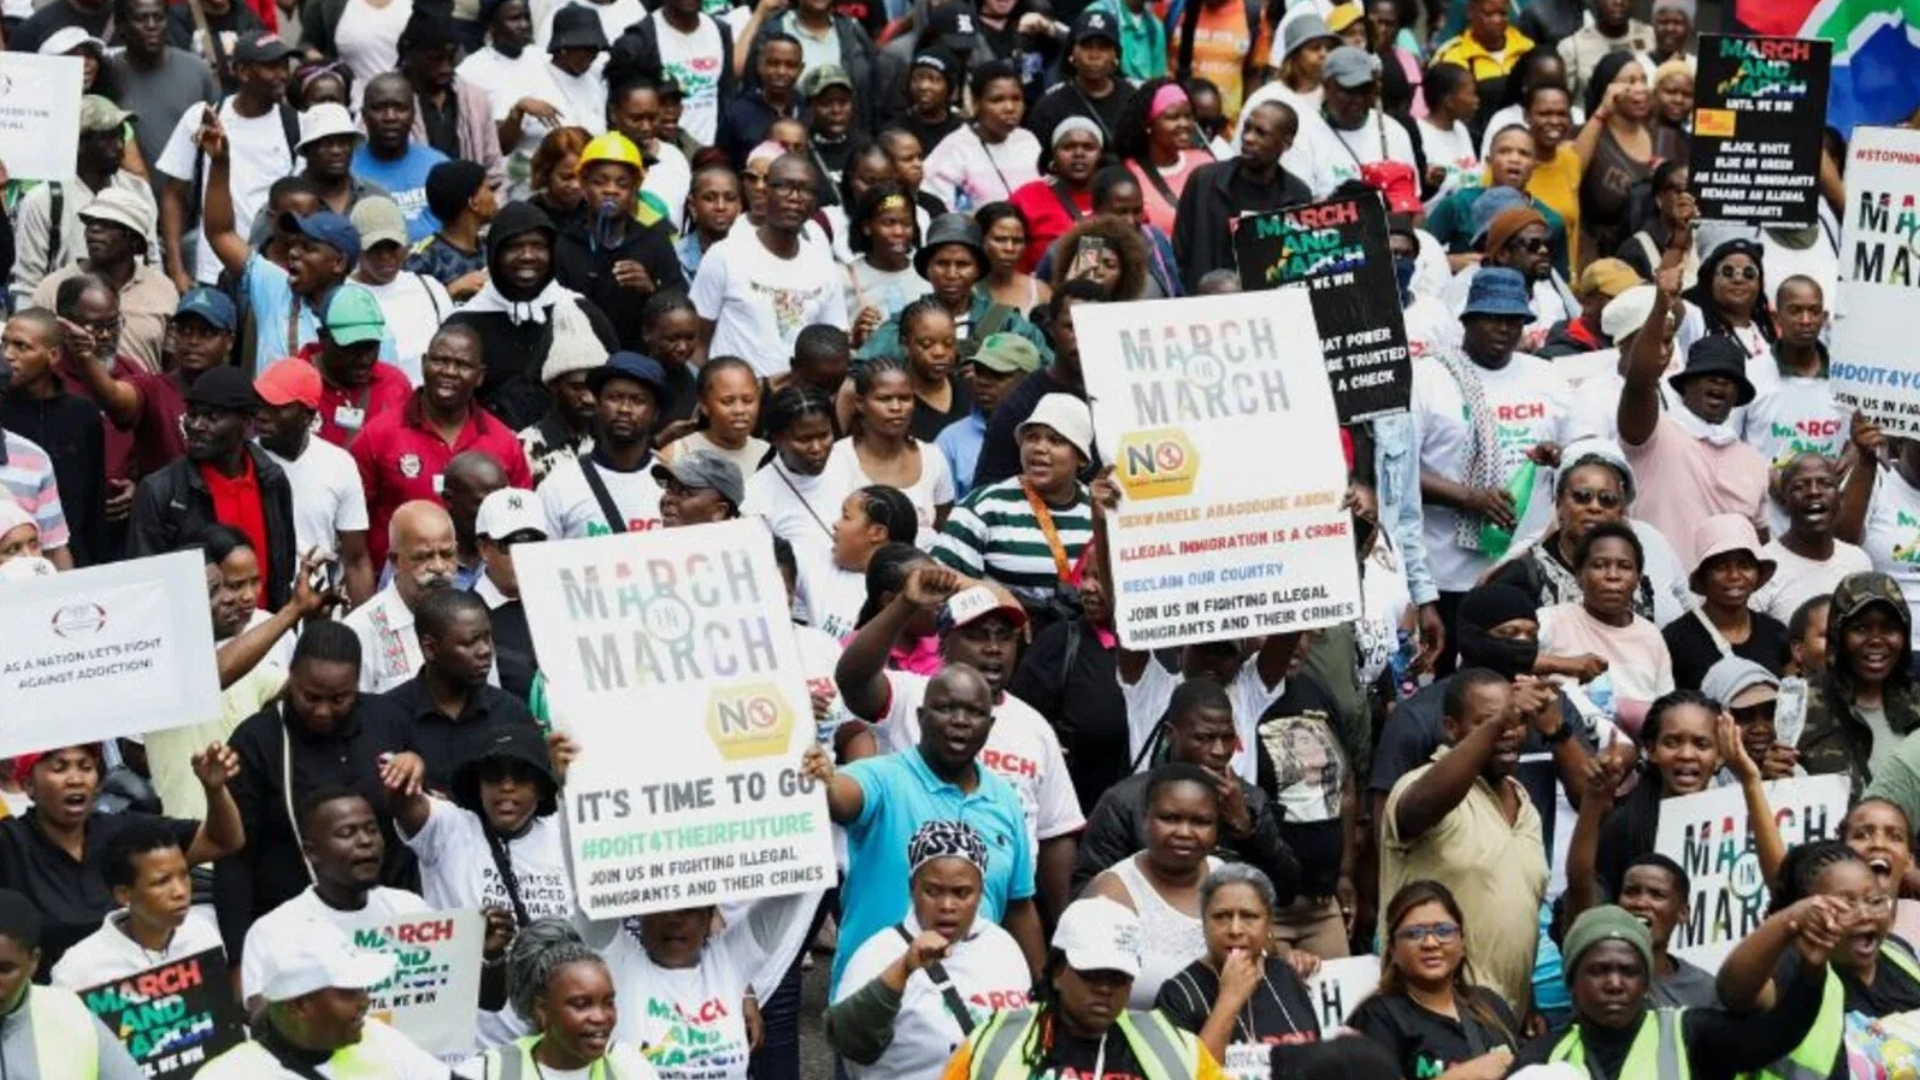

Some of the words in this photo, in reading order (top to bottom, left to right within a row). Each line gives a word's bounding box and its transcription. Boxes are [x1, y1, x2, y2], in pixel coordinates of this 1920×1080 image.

[1719, 37, 1811, 61] MARCH
[1738, 59, 1791, 78] AND
[1254, 201, 1360, 239] MARCH
[1281, 228, 1341, 257] AND
[1312, 276, 1331, 290] WE
[1118, 316, 1280, 372] MARCH
[1346, 327, 1392, 349] POWER
[1346, 347, 1406, 370] TRUSTED
[1130, 368, 1291, 427] MARCH
[1337, 378, 1348, 392] A
[1350, 370, 1395, 390] CHECK
[1833, 391, 1859, 407] JOIN
[1863, 396, 1879, 410] US
[1883, 399, 1896, 412] IN
[1119, 541, 1177, 562] ILLEGAL
[1179, 531, 1268, 557] IMMIGRATION
[1272, 529, 1286, 544] IS
[1290, 527, 1301, 542] A
[1304, 521, 1348, 540] CRIME
[557, 548, 761, 621] MARCH
[1122, 575, 1184, 594] RECLAIM
[1187, 569, 1216, 586] OUR
[1220, 562, 1285, 582] COUNTRY
[1127, 605, 1159, 623] JOIN
[1162, 601, 1182, 619] US
[1186, 600, 1200, 616] IN
[1203, 592, 1268, 613] FIGHTING
[1272, 585, 1329, 604] ILLEGAL
[1128, 619, 1216, 643] IMMIGRANTS
[1220, 615, 1250, 632] AND
[1254, 609, 1297, 627] THEIR
[1301, 601, 1355, 621] CRIMES
[3, 662, 21, 675] AS
[23, 660, 34, 671] A
[36, 651, 85, 669] NATION
[124, 636, 162, 653] FIGHT
[576, 614, 778, 692] MARCH
[18, 671, 74, 690] AGAINST
[982, 748, 1037, 780] RCH
[577, 788, 632, 825] IT'S
[641, 777, 716, 816] TIME
[726, 771, 767, 805] TO
[778, 767, 816, 798] GO
[581, 811, 816, 862] #DOIT4THEIRFUTURE
[589, 868, 621, 886] JOIN
[625, 865, 646, 882] US
[650, 863, 664, 879] IN
[669, 854, 735, 877] FIGHTING
[739, 845, 799, 867] ILLEGAL
[590, 884, 681, 909] IMMIGRANTS
[687, 879, 717, 897] AND
[722, 872, 764, 893] THEIR
[769, 866, 824, 886] CRIMES
[354, 918, 454, 948] MARCH
[1676, 885, 1762, 950] MAR
[86, 958, 203, 1014] MARCH
[120, 994, 186, 1035] AND
